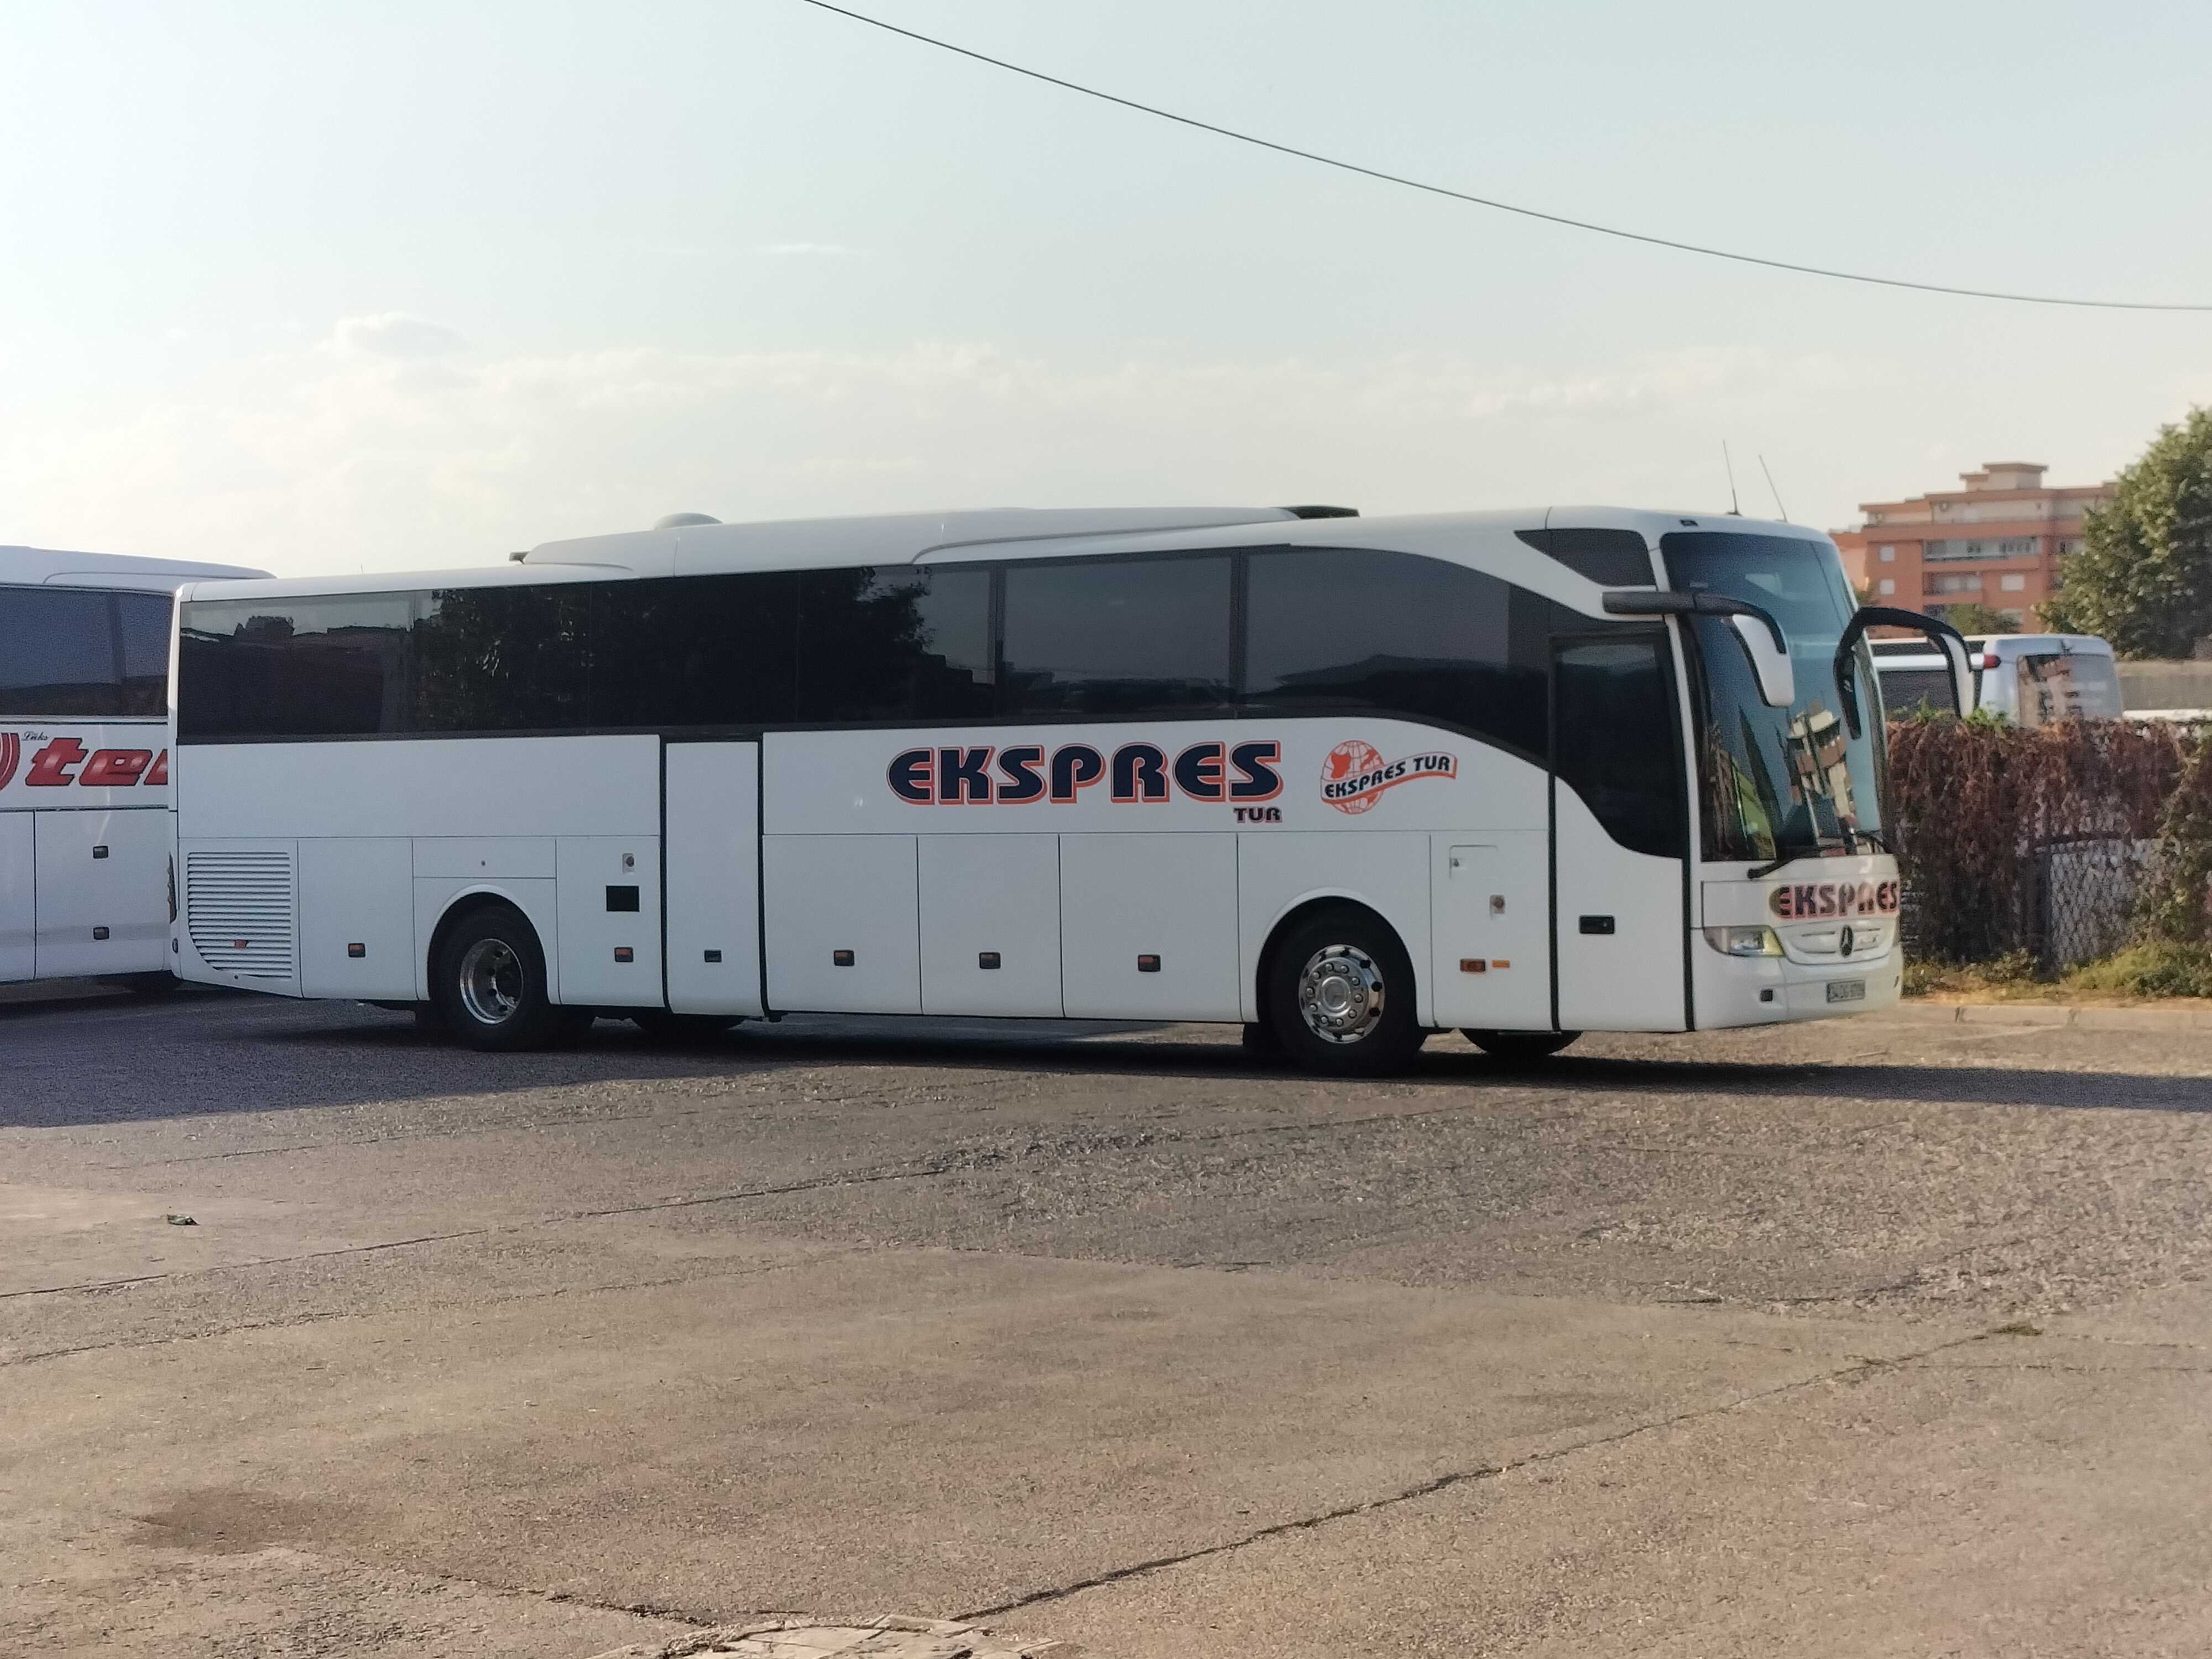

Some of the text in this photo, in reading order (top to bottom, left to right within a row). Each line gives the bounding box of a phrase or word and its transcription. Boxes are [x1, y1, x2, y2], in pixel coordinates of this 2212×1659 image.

[886, 740, 1284, 805] EKSPRES
[1324, 755, 1450, 798] EKSPRES TUR
[1233, 807, 1282, 823] TUR
